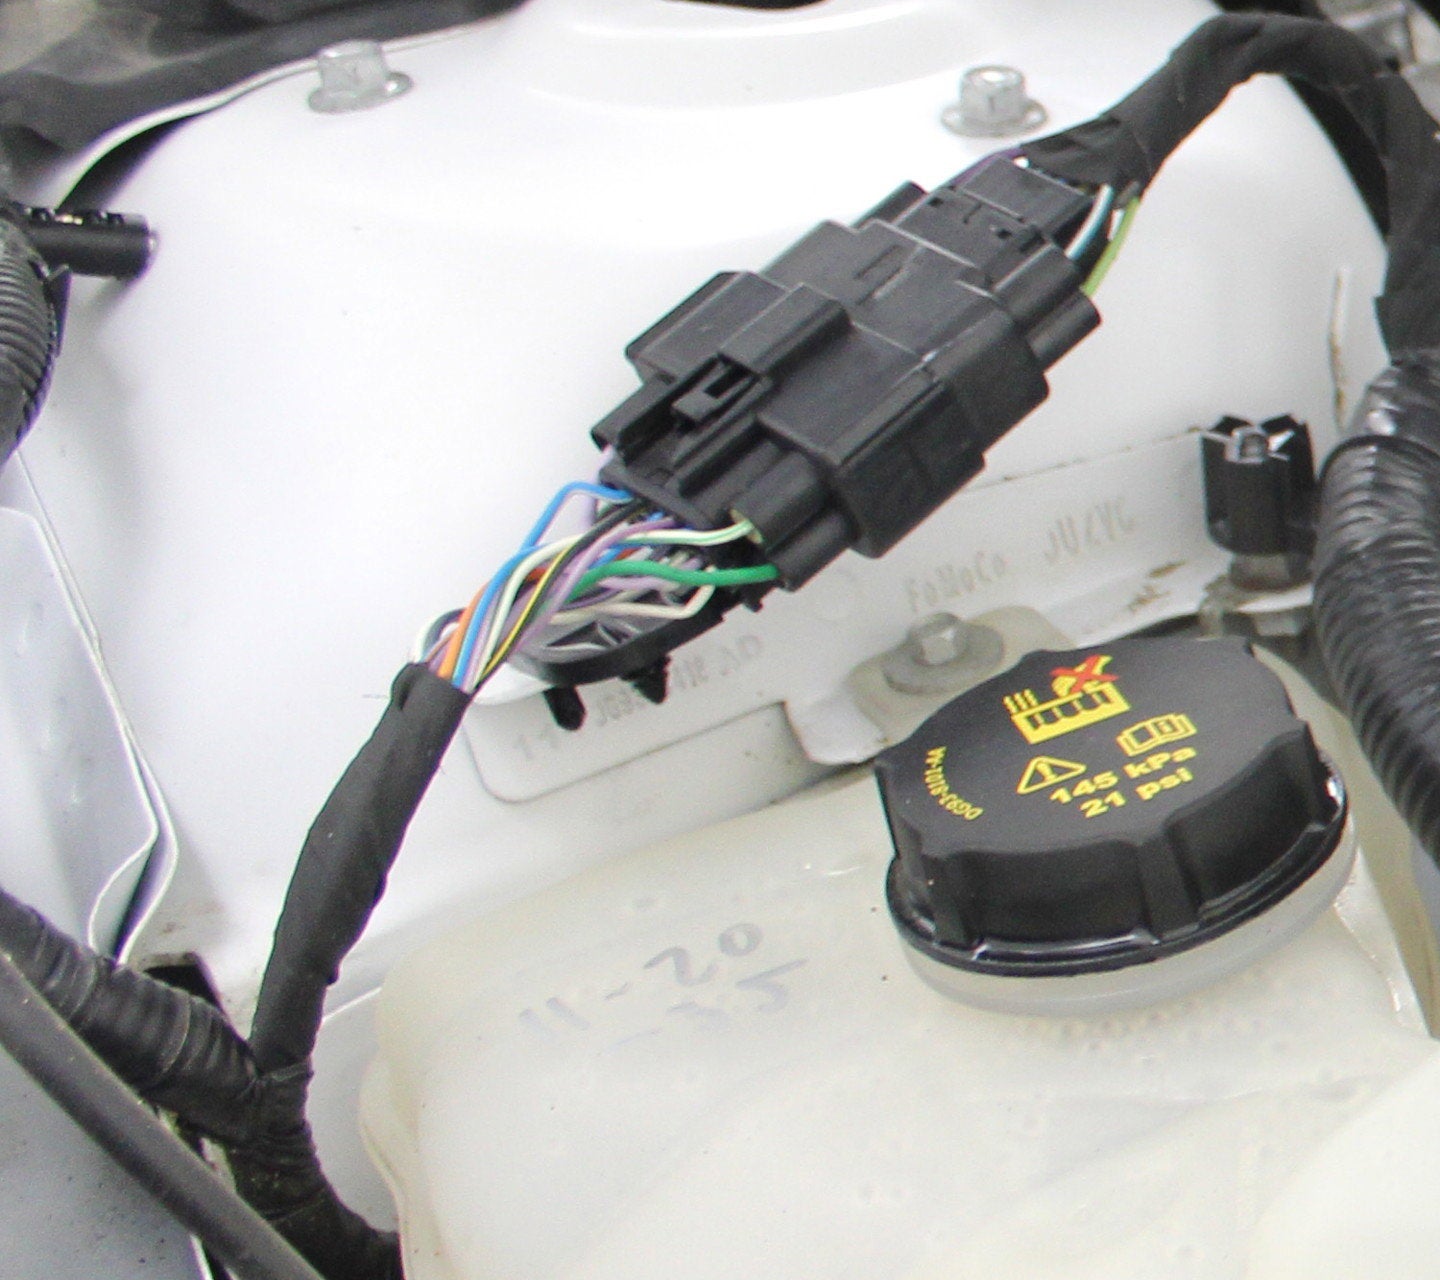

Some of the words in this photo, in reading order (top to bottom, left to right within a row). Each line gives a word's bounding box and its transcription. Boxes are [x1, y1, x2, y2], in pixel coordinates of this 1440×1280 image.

[1050, 771, 1118, 804] 145
[1125, 746, 1197, 780] kPa
[1080, 791, 1125, 818] 21
[1137, 767, 1194, 801] psi
